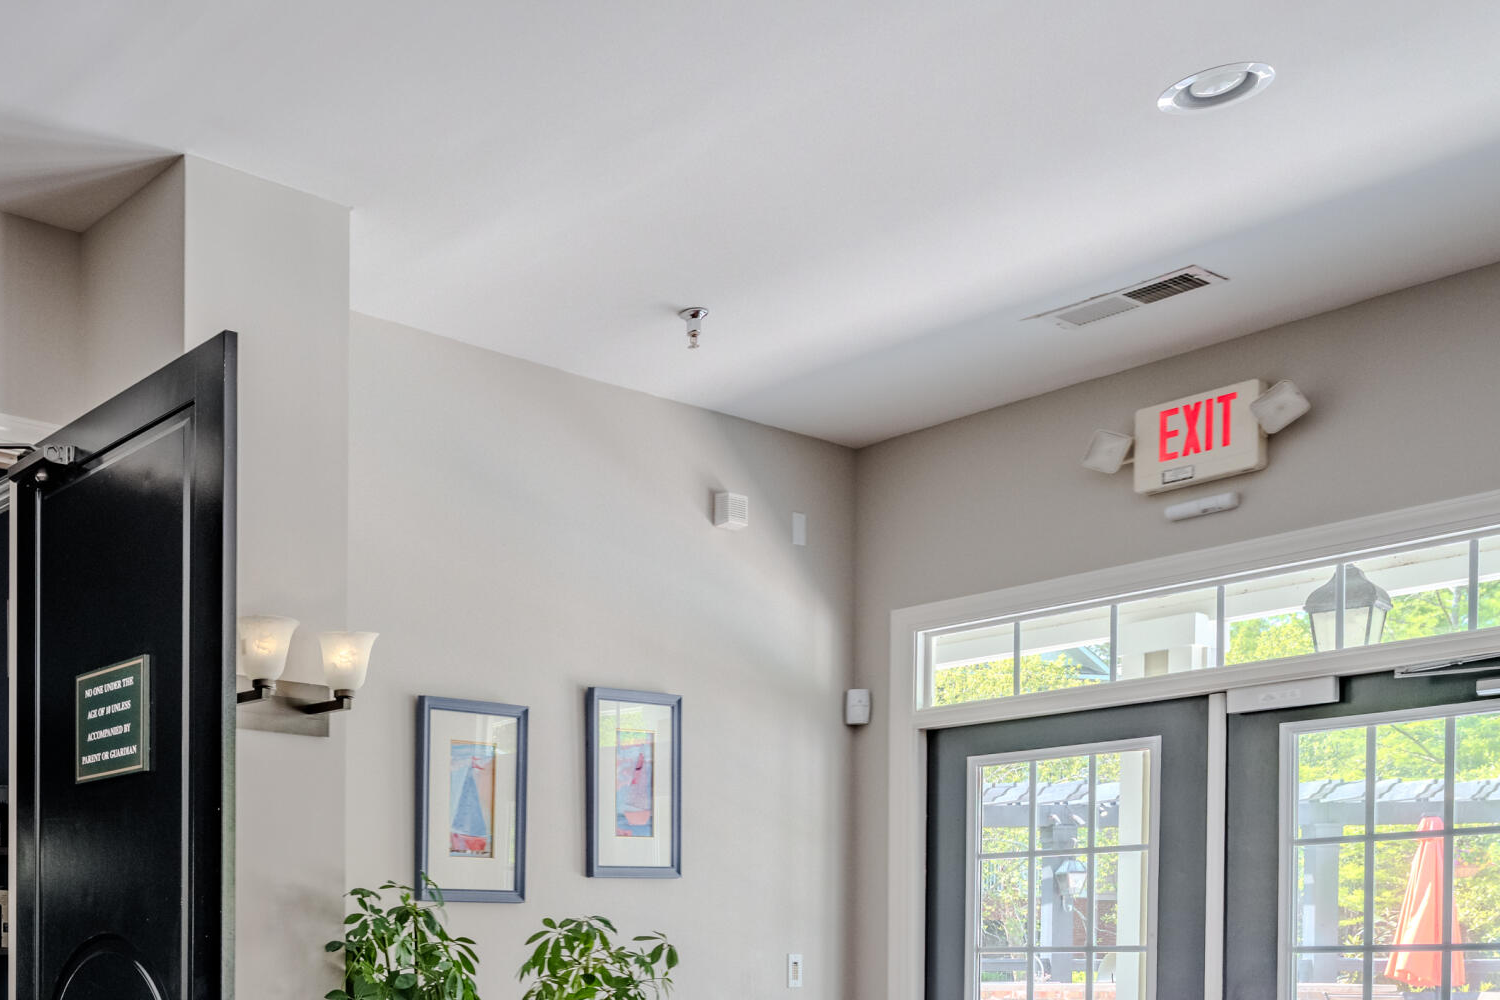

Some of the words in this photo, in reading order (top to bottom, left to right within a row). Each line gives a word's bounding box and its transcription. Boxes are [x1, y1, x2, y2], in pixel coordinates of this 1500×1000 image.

[1158, 392, 1238, 463] EXIT
[84, 689, 92, 699] NO
[93, 685, 104, 696] ONE
[104, 680, 122, 693] UNDER
[122, 676, 134, 687] THE
[87, 709, 98, 720] AGE
[111, 700, 131, 713] UNLESS
[87, 725, 123, 742] ACCOMPANIED
[123, 723, 131, 733] BY
[81, 752, 101, 765] PARENT
[101, 751, 109, 761] OR
[110, 745, 137, 759] GUARDIAN
